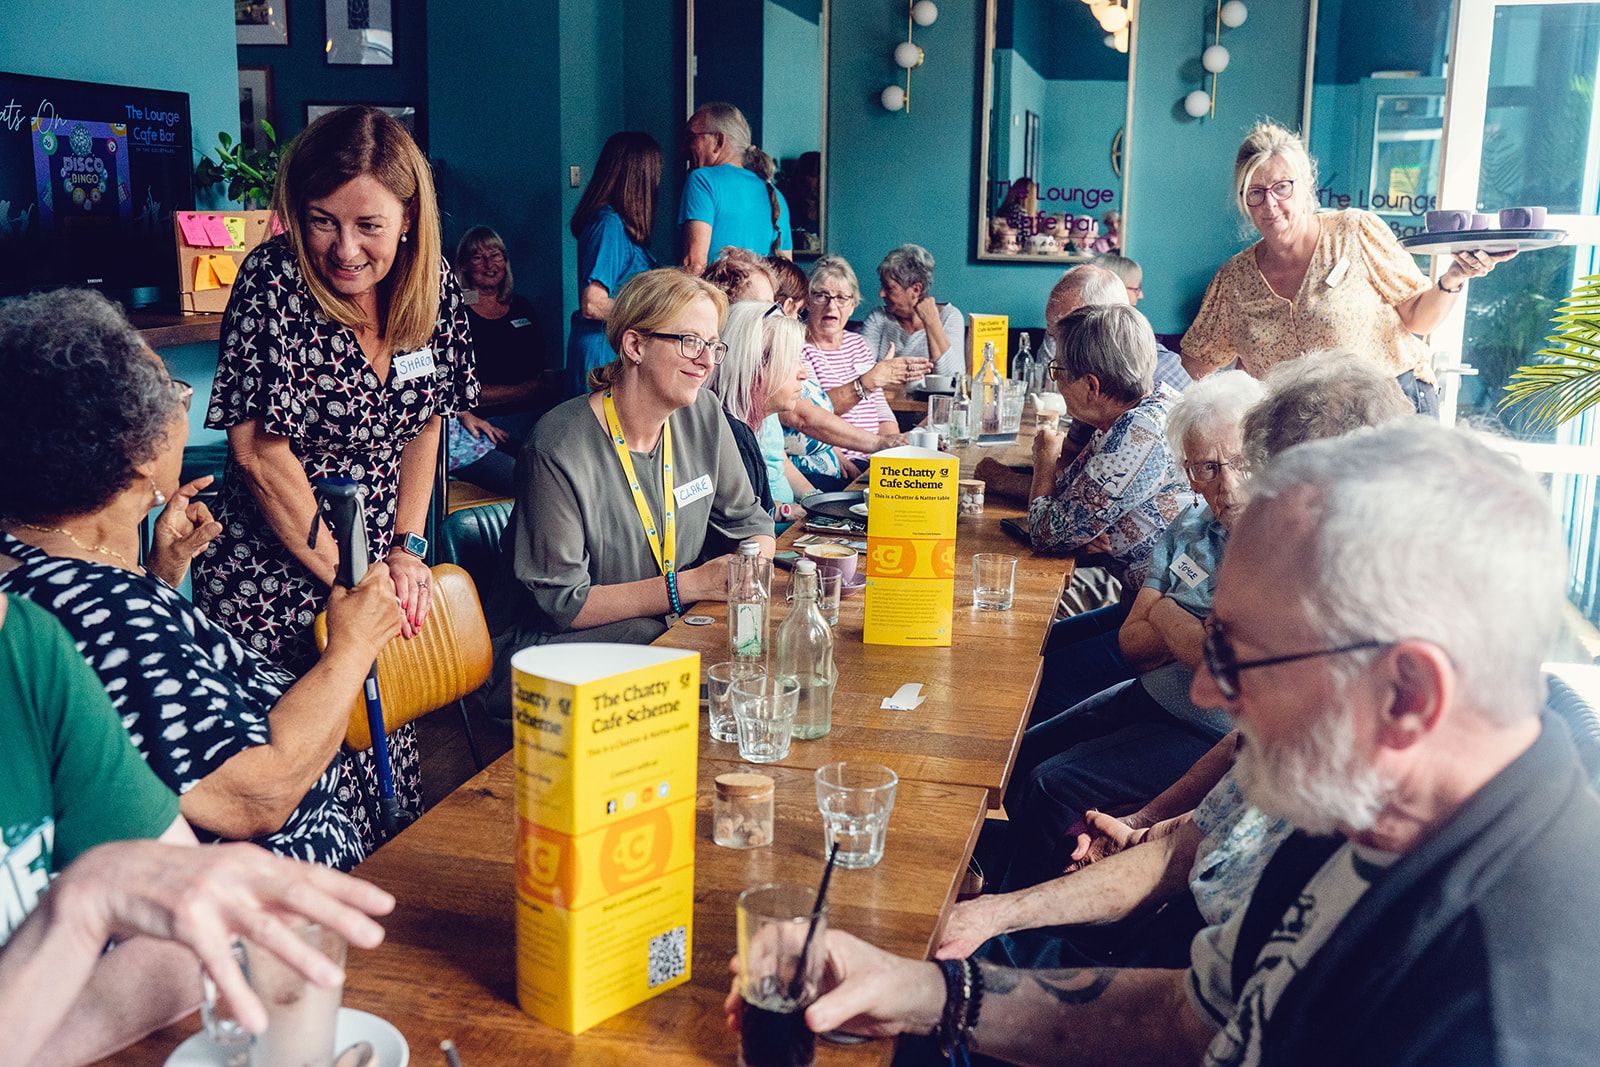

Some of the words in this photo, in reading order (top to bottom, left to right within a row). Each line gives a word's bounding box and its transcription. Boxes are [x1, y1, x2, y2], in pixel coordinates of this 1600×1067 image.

[0, 98, 26, 131] ats
[36, 98, 68, 134] On
[125, 104, 143, 120] The
[144, 106, 180, 127] Lounge
[134, 126, 158, 146] Cafe
[160, 128, 176, 142] Bar
[63, 156, 104, 173] DISCO
[72, 174, 98, 184] BINGO
[1036, 182, 1114, 210] Lounge
[1318, 186, 1350, 208] The
[1064, 213, 1098, 232] Bar
[880, 467, 900, 476] The
[902, 467, 936, 479] Chatty
[880, 479, 902, 488] Cafe
[904, 480, 943, 489] Scheme
[680, 478, 708, 500] CLARE
[593, 692, 620, 711] The
[623, 680, 670, 702] Chatty
[591, 712, 622, 734] Cafe
[626, 700, 680, 724] Scheme
